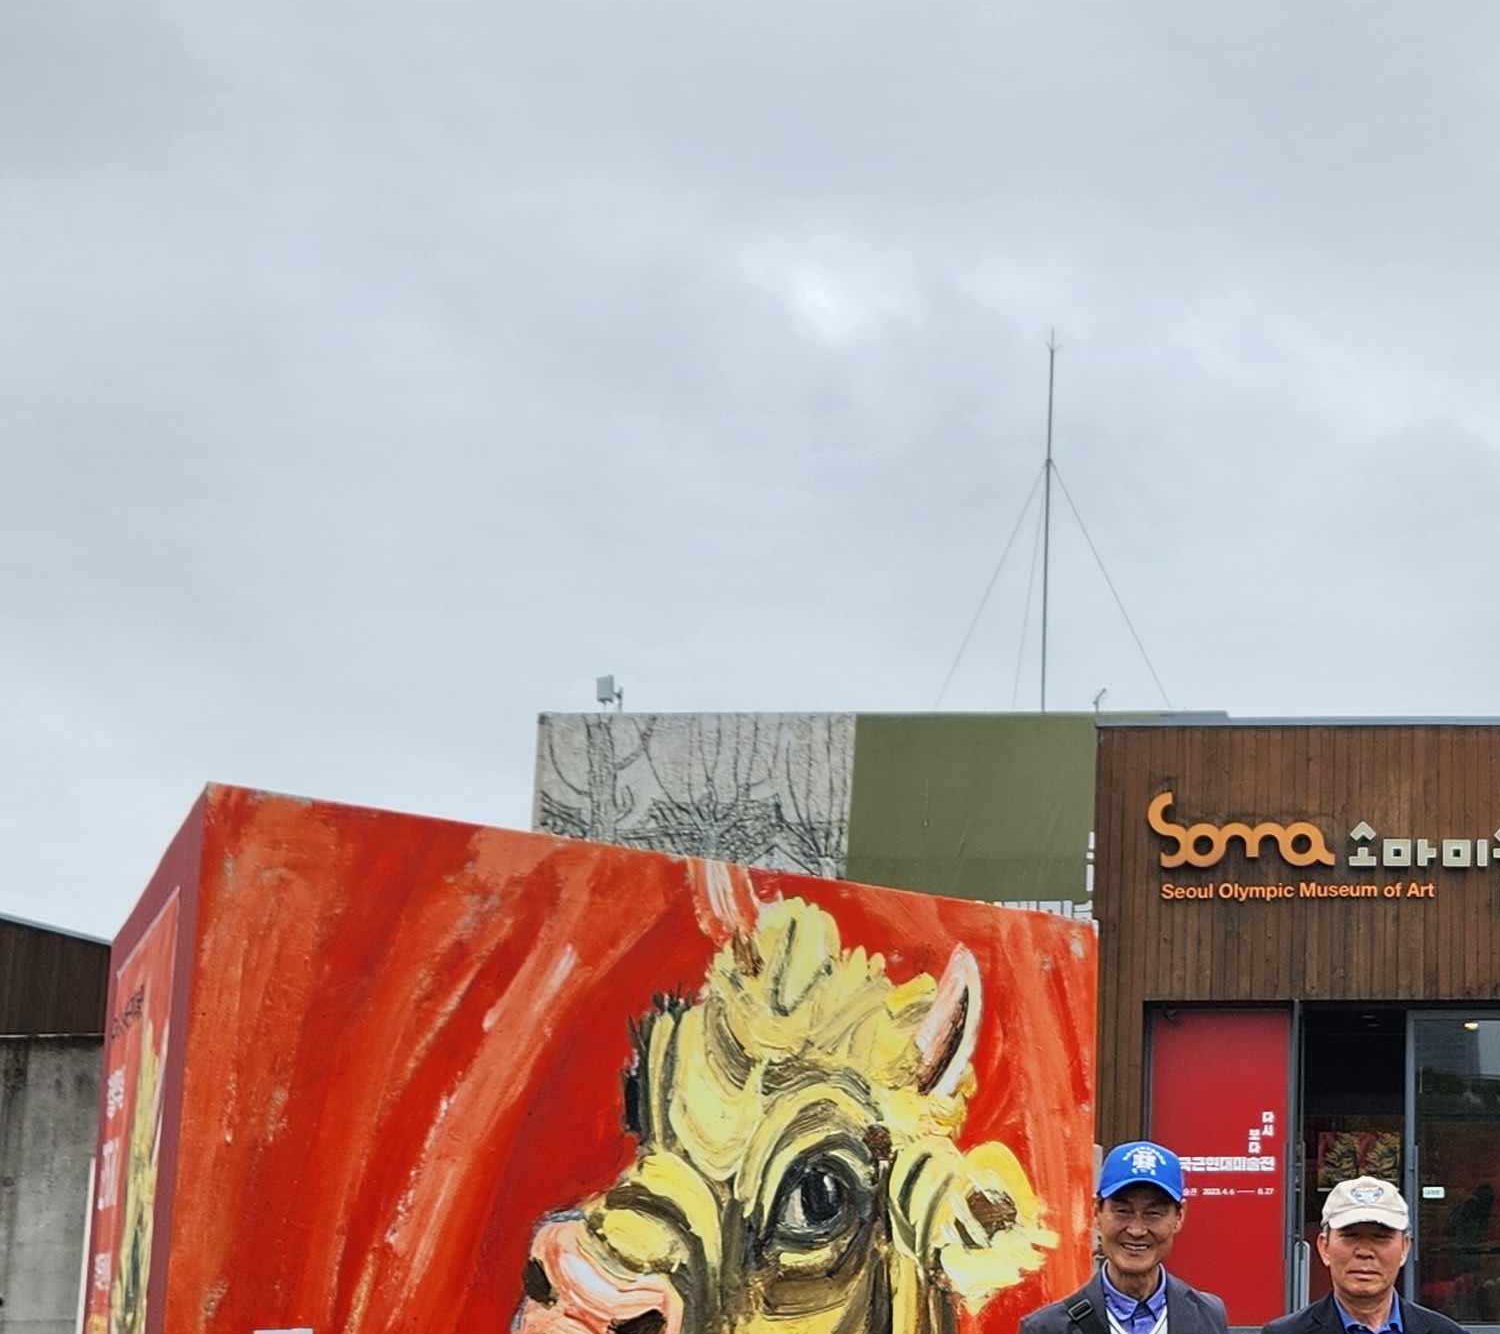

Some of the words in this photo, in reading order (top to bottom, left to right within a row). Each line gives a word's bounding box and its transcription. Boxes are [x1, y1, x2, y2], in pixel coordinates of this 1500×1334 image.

[1160, 883, 1214, 899] Seoul
[1218, 882, 1295, 902] Olympic
[1299, 881, 1378, 898] Museum
[1383, 882, 1403, 898] of
[1406, 882, 1436, 898] Art
[1261, 1110, 1275, 1137] 다시
[1248, 1128, 1261, 1154] 보다
[1178, 1156, 1275, 1172] 국근현대미술전
